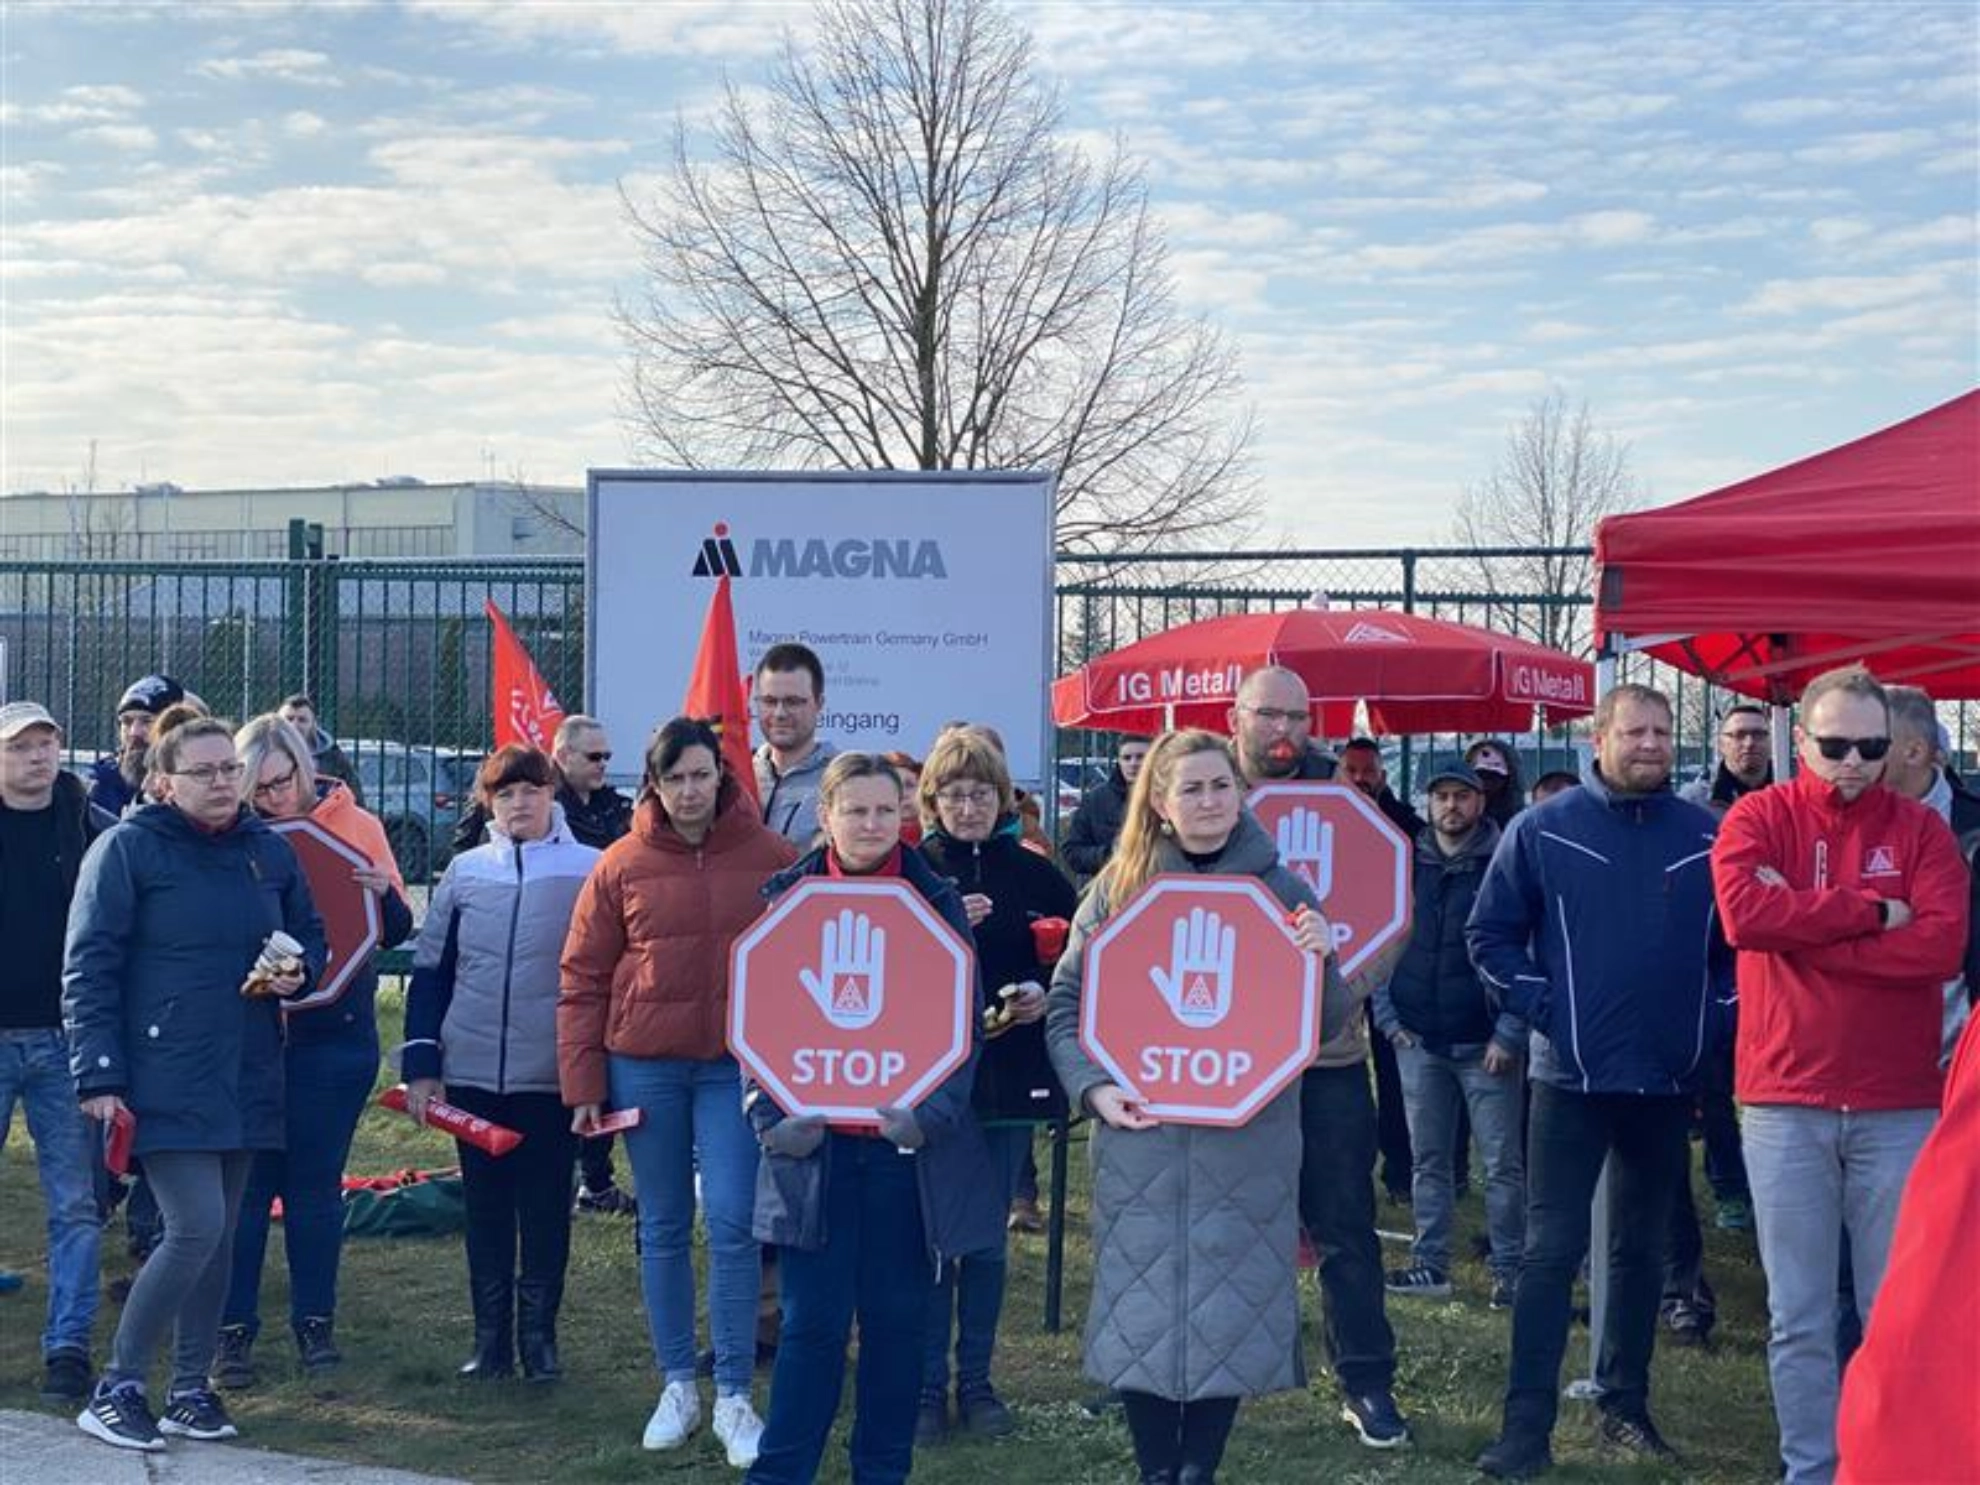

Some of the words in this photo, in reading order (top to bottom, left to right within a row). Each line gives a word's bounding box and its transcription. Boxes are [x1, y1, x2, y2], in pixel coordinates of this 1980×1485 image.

[751, 538, 947, 578] MAGNA
[749, 630, 796, 646] Magna
[799, 630, 872, 645] Powertrain
[875, 630, 938, 648] Germany
[942, 631, 989, 646] GmbH
[1118, 672, 1153, 702] IG
[1160, 664, 1242, 697] Metall
[1513, 666, 1531, 695] IG
[1532, 668, 1585, 701] Metall
[748, 707, 899, 734] eingang
[791, 1048, 905, 1087] STOP
[1139, 1046, 1252, 1087] STOP
